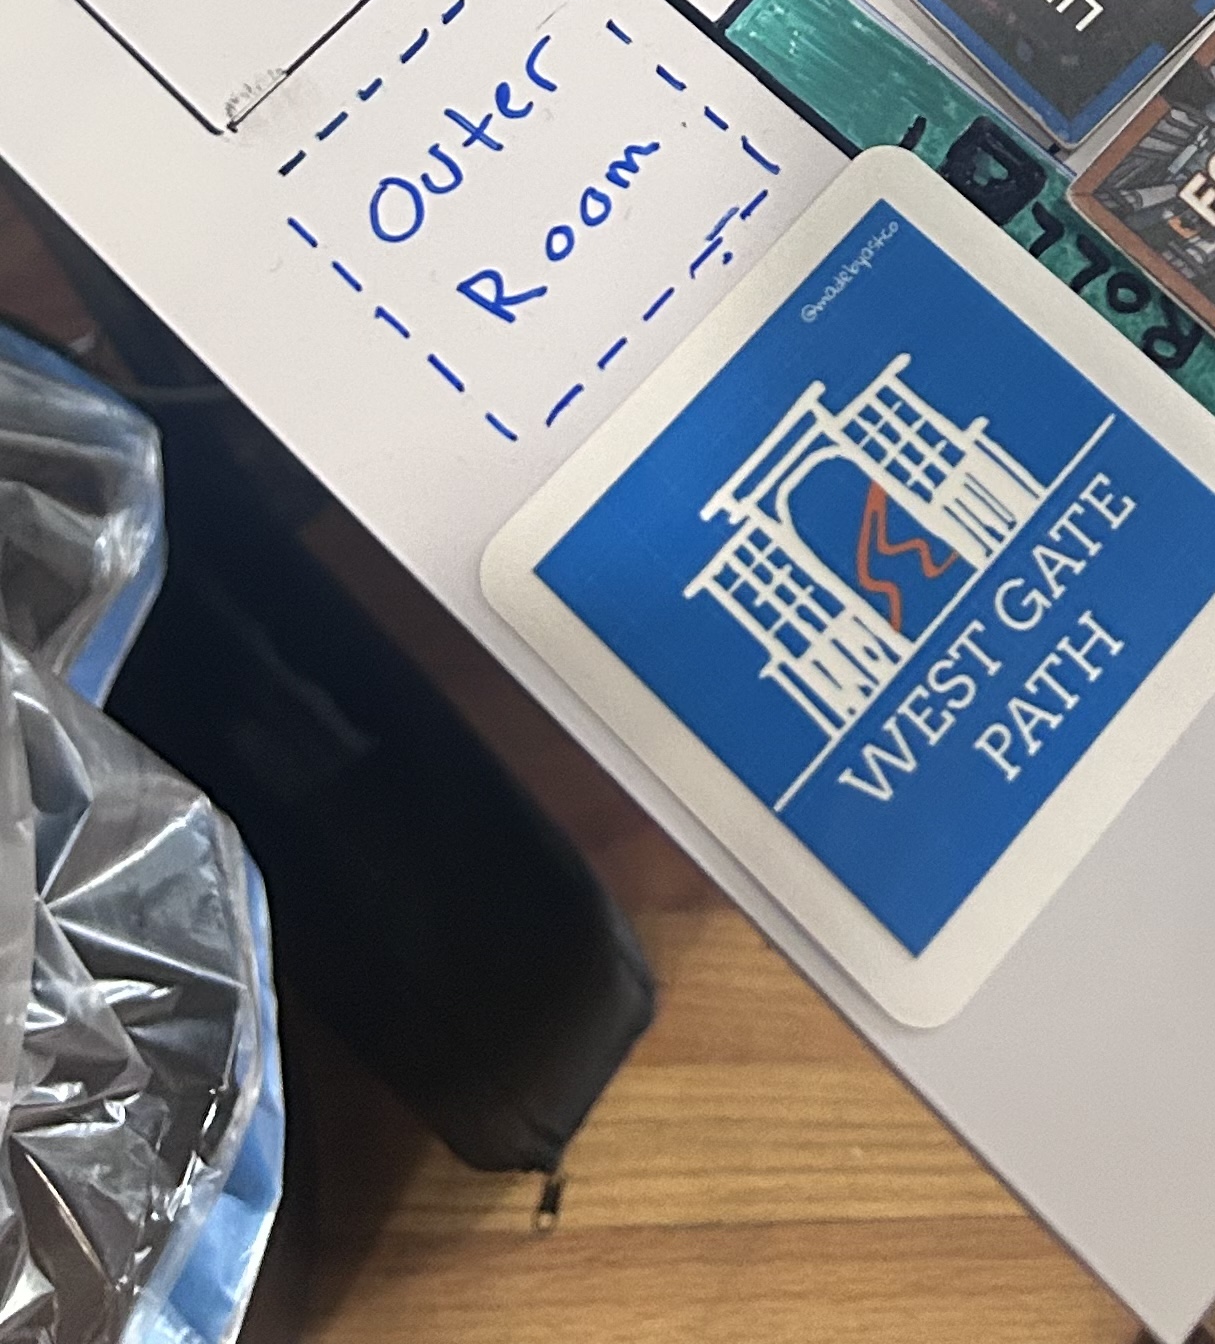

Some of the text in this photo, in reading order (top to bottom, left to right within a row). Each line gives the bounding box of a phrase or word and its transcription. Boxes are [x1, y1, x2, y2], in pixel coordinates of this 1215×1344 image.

[369, 36, 557, 243] Outer
[457, 142, 660, 323] Room
[839, 473, 1137, 805] WEST GATE
[973, 609, 1124, 783] PATH
